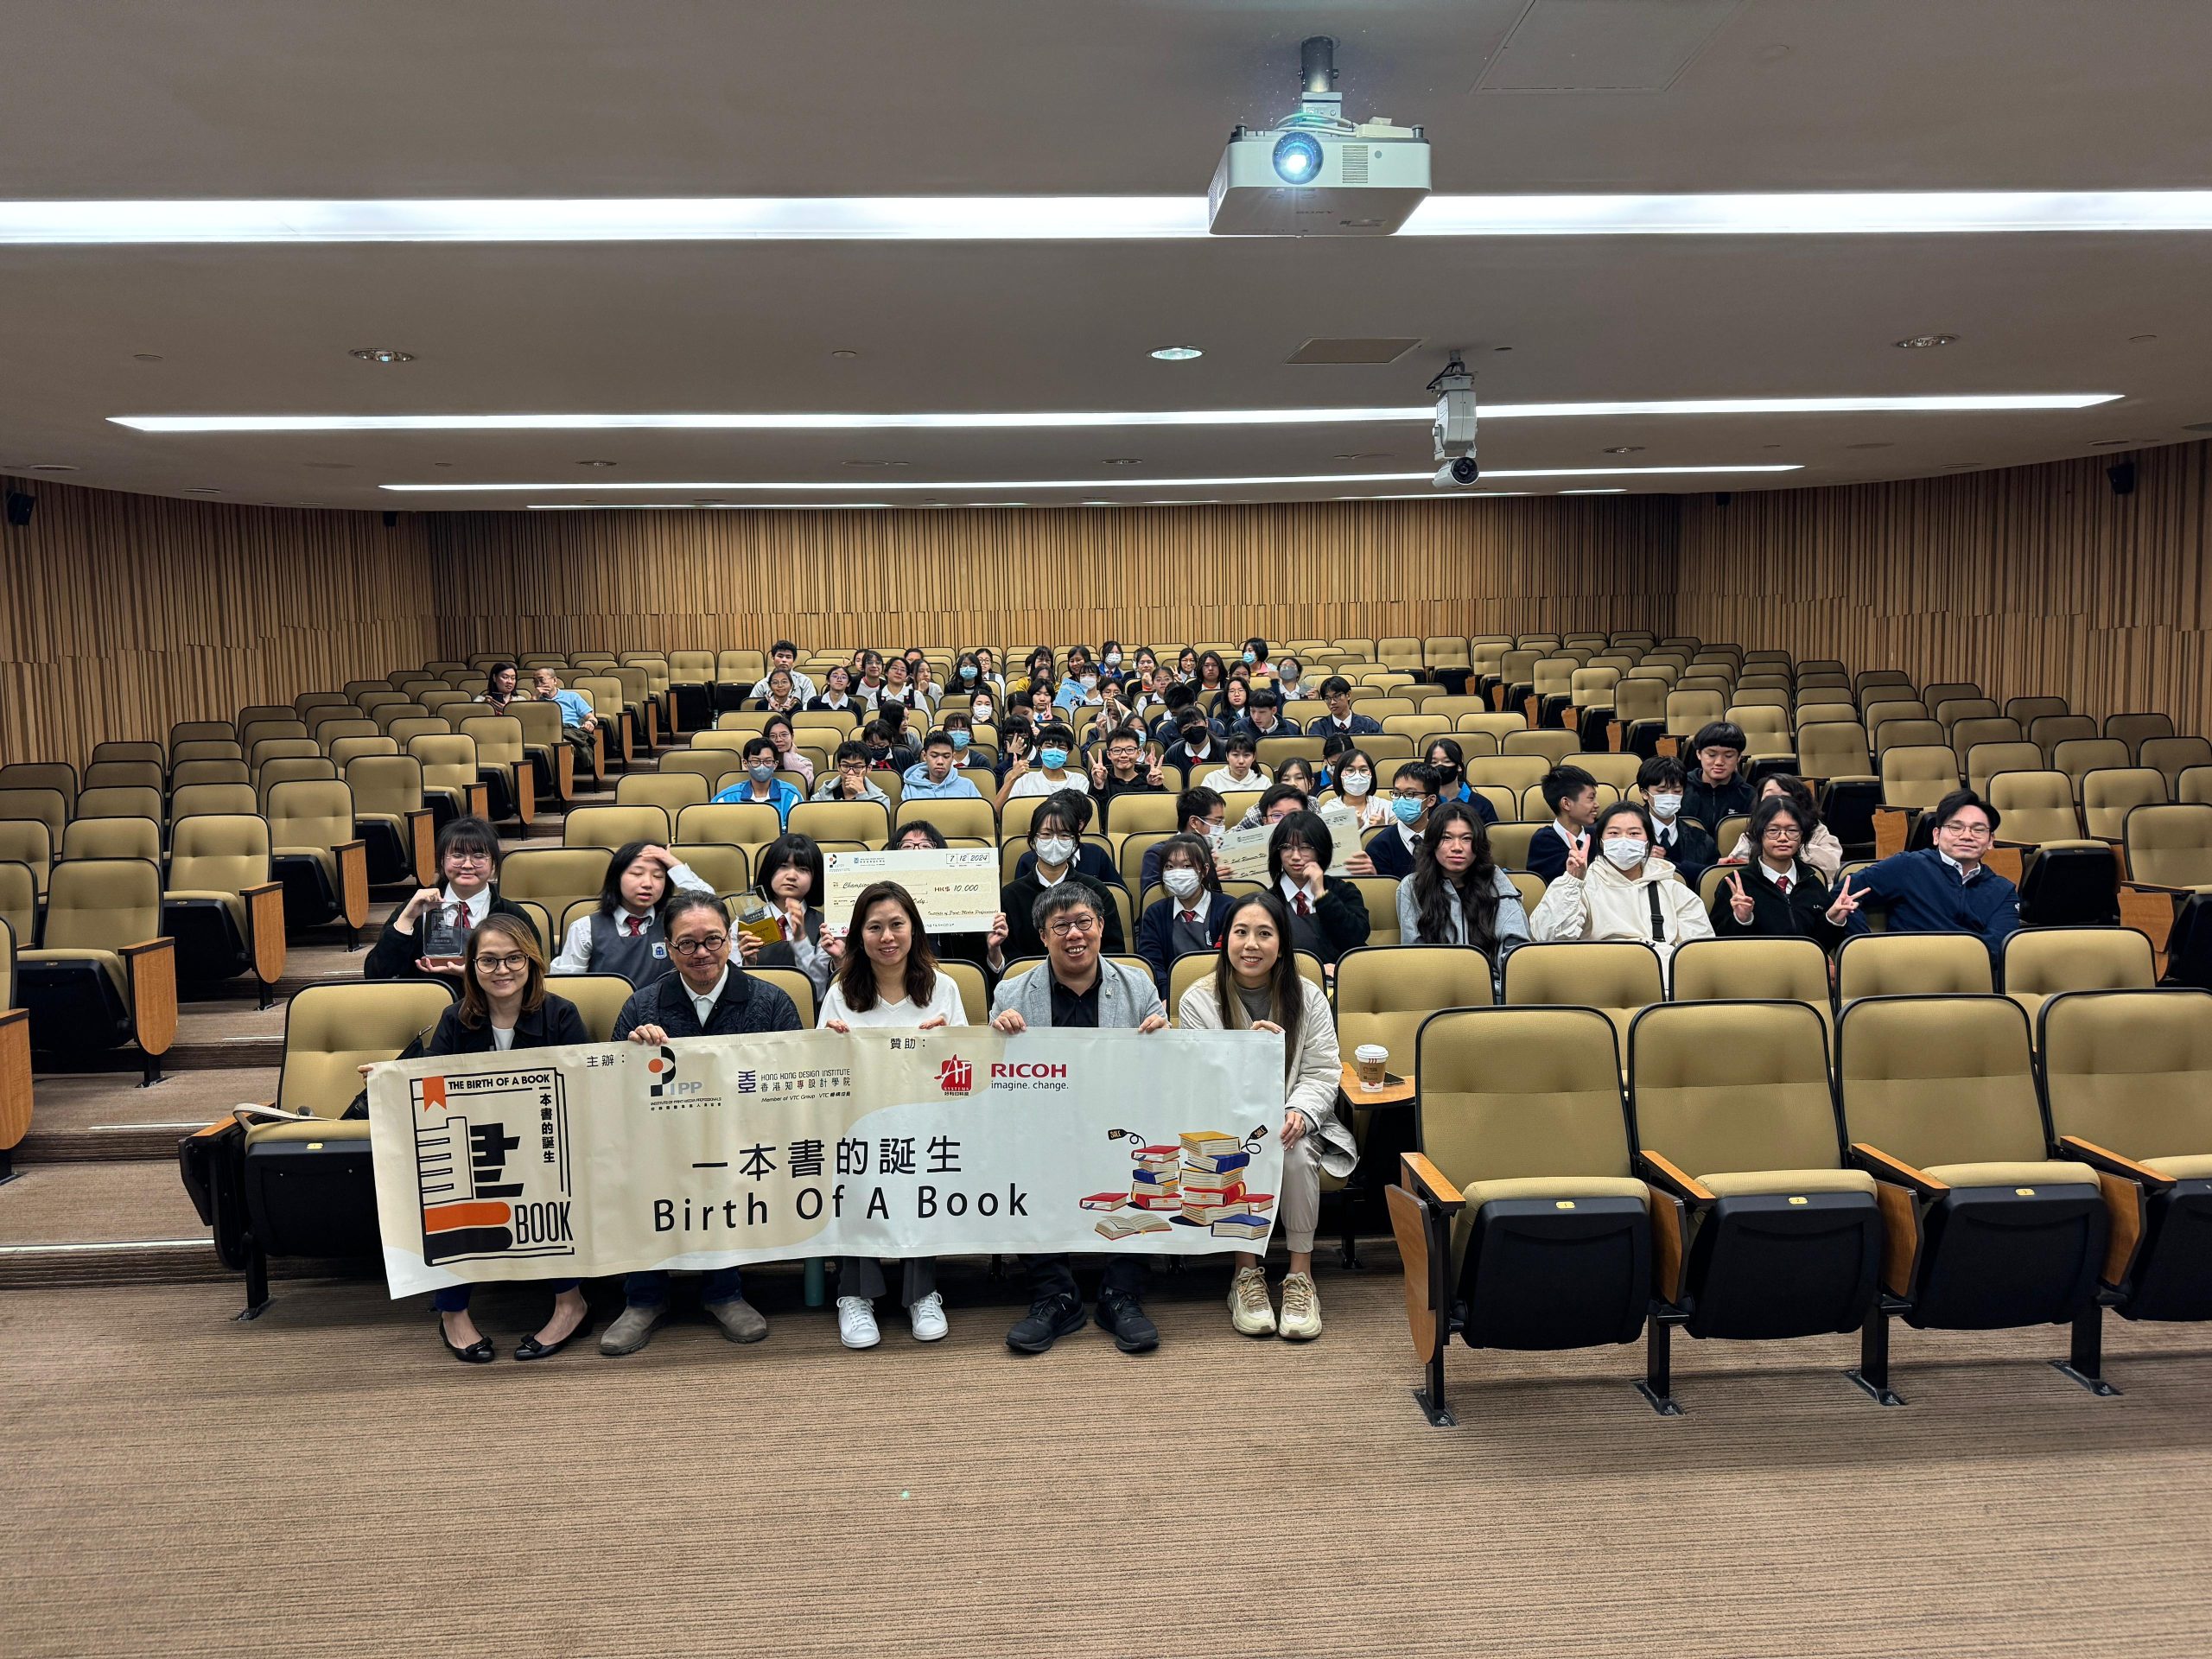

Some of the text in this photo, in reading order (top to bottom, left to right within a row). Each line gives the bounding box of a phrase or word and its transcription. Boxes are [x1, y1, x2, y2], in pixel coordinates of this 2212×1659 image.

[448, 1074, 550, 1090] THE BIRTH OF A BOOK
[779, 1071, 797, 1080] KONG
[798, 1070, 820, 1078] DESIGN
[822, 1068, 850, 1077] INSTITUTE
[990, 1063, 1067, 1078] RICOH
[990, 1080, 1069, 1091] imagine. change.
[538, 1085, 556, 1164] 一本書的誕生
[691, 1135, 963, 1182] 一本書的誕生
[653, 1182, 1029, 1232] Birth Of A Book
[514, 1200, 574, 1245] BOOK
